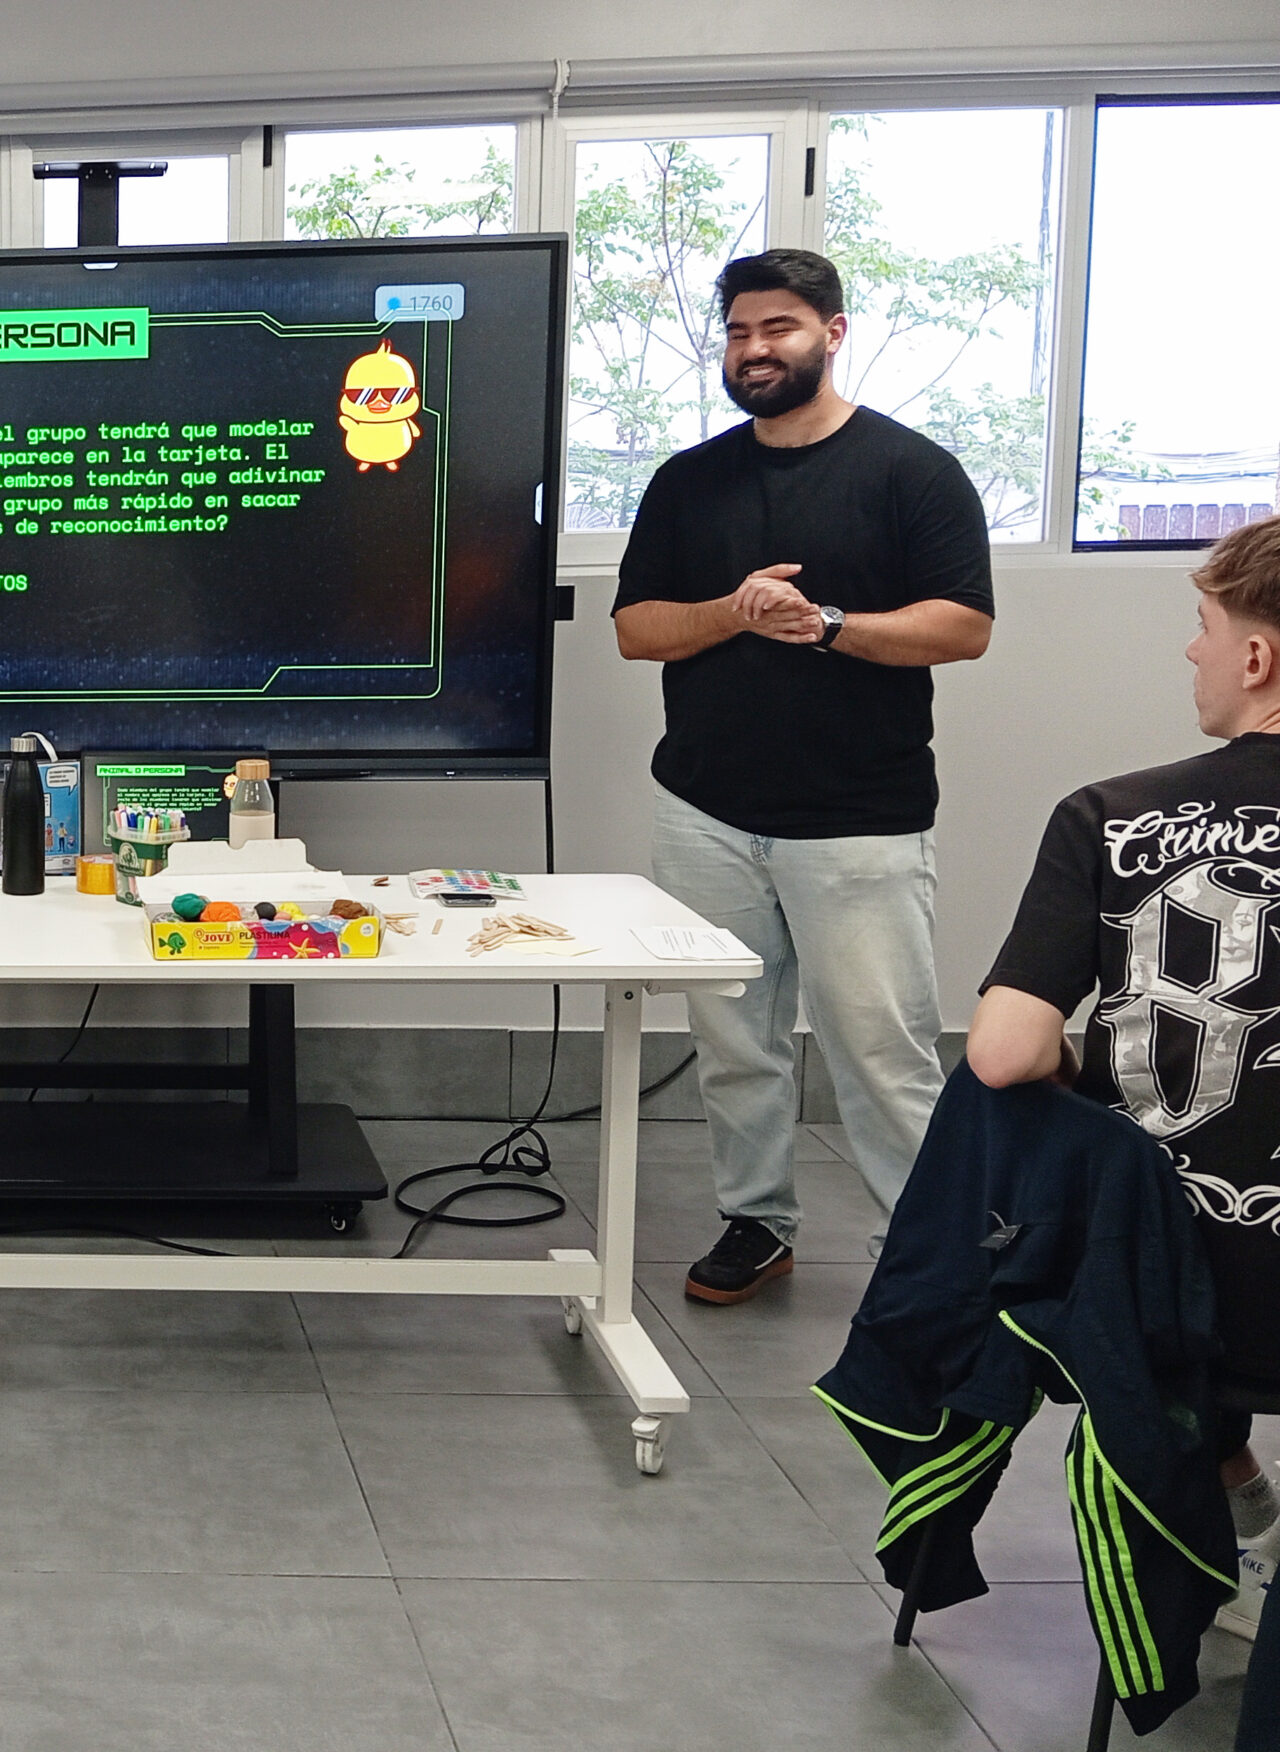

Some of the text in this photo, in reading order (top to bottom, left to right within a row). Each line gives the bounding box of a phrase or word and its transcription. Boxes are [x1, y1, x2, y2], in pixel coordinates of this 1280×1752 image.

[409, 294, 453, 312] 1760
[26, 426, 87, 444] grupo
[97, 421, 171, 440] tendrá
[180, 424, 218, 442] que
[228, 419, 315, 437] modelar
[85, 449, 110, 465] en
[121, 445, 147, 464] la
[157, 444, 250, 465] tarjeta.
[265, 442, 290, 460] El
[85, 468, 170, 487] tendrán
[180, 471, 218, 489] que
[228, 466, 326, 485] adivinar
[3, 497, 64, 516] grupo
[73, 493, 110, 511] más
[121, 493, 193, 513] rápido
[204, 494, 229, 509] en
[240, 493, 301, 508] sacar
[15, 518, 39, 534] de
[50, 514, 228, 533] reconocimiento?
[203, 933, 232, 942] JOVI
[1241, 1556, 1265, 1575] NIKE
